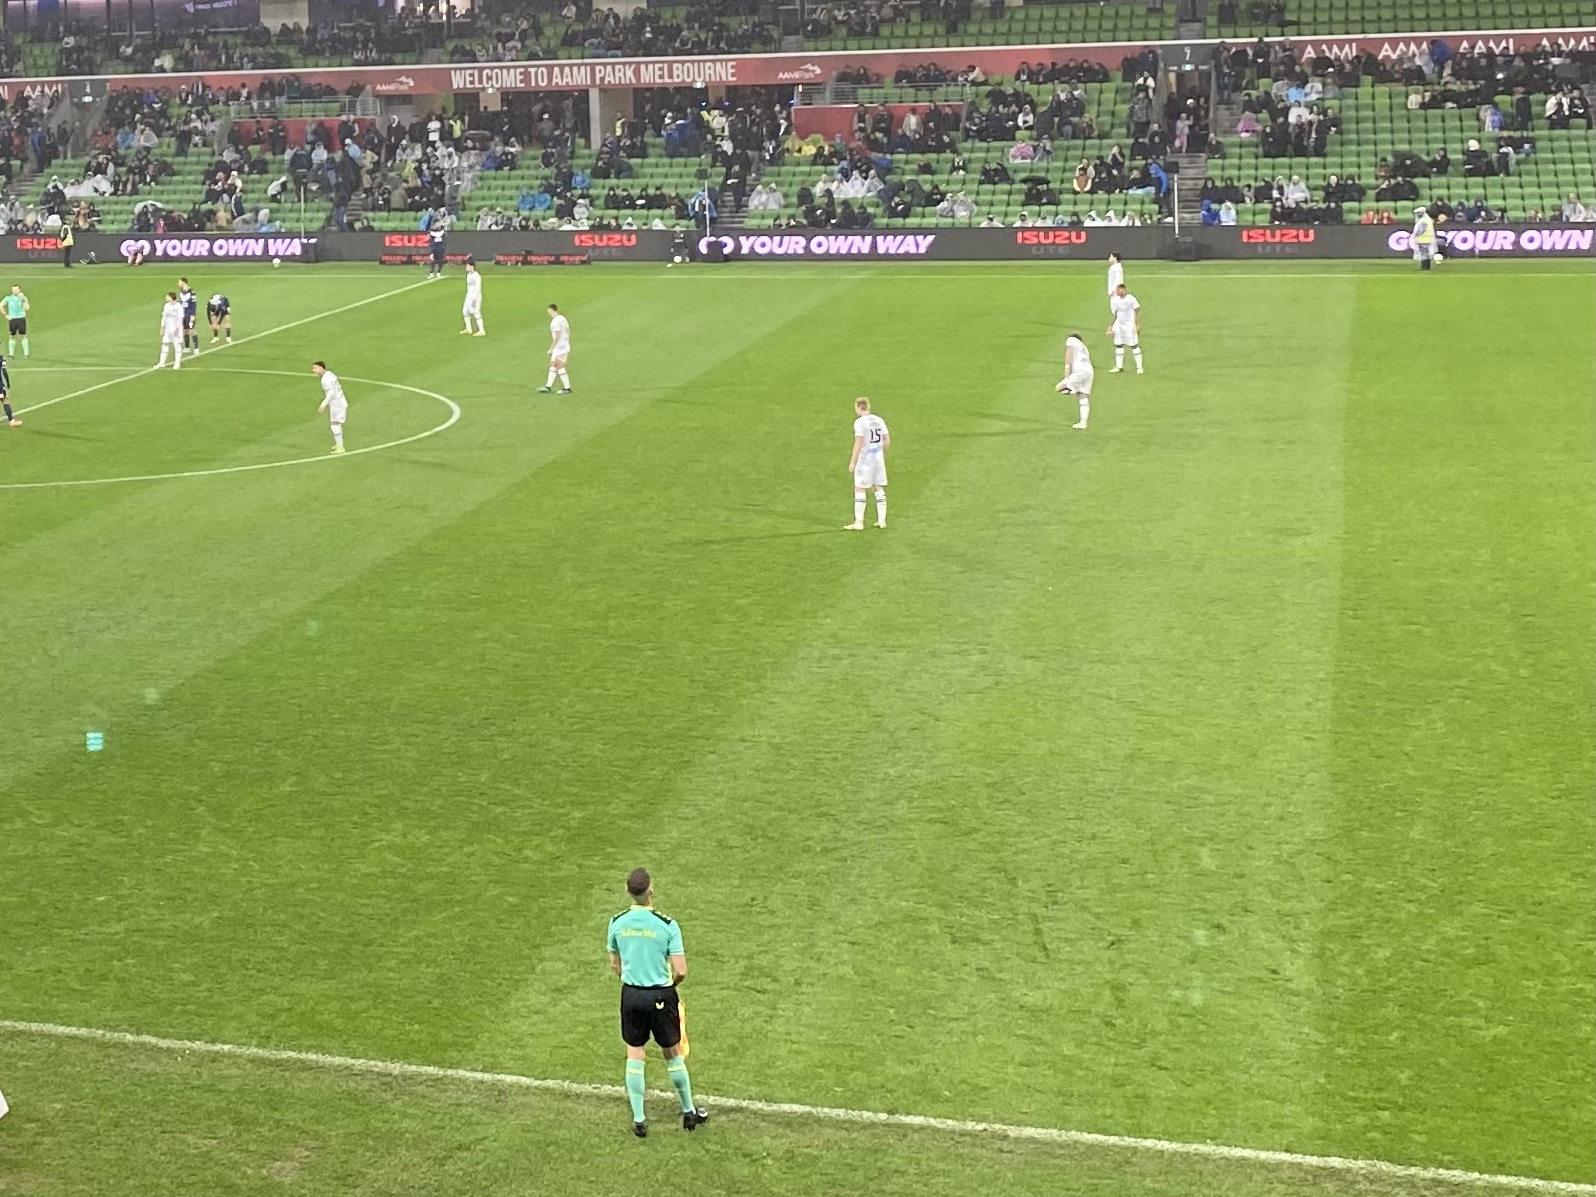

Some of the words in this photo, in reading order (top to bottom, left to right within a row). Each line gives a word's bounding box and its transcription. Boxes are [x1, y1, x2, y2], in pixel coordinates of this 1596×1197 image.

[451, 69, 525, 89] WELCOME
[527, 68, 548, 87] TO
[552, 65, 591, 86] AAMI
[595, 64, 637, 85] PARK
[640, 61, 737, 83] MELBOURNE
[385, 234, 430, 247] ISUZ
[574, 234, 637, 247] ISUZU
[1015, 230, 1088, 244] ISUZU
[1240, 228, 1316, 243] ISUZU
[1519, 230, 1594, 250] OWN
[154, 239, 211, 256] YOUR
[212, 239, 265, 256] OWN
[738, 235, 807, 255] YOUR
[809, 235, 873, 254] OWN
[876, 234, 937, 254] WAY
[1031, 245, 1071, 254] UTE
[869, 429, 881, 443] 15
